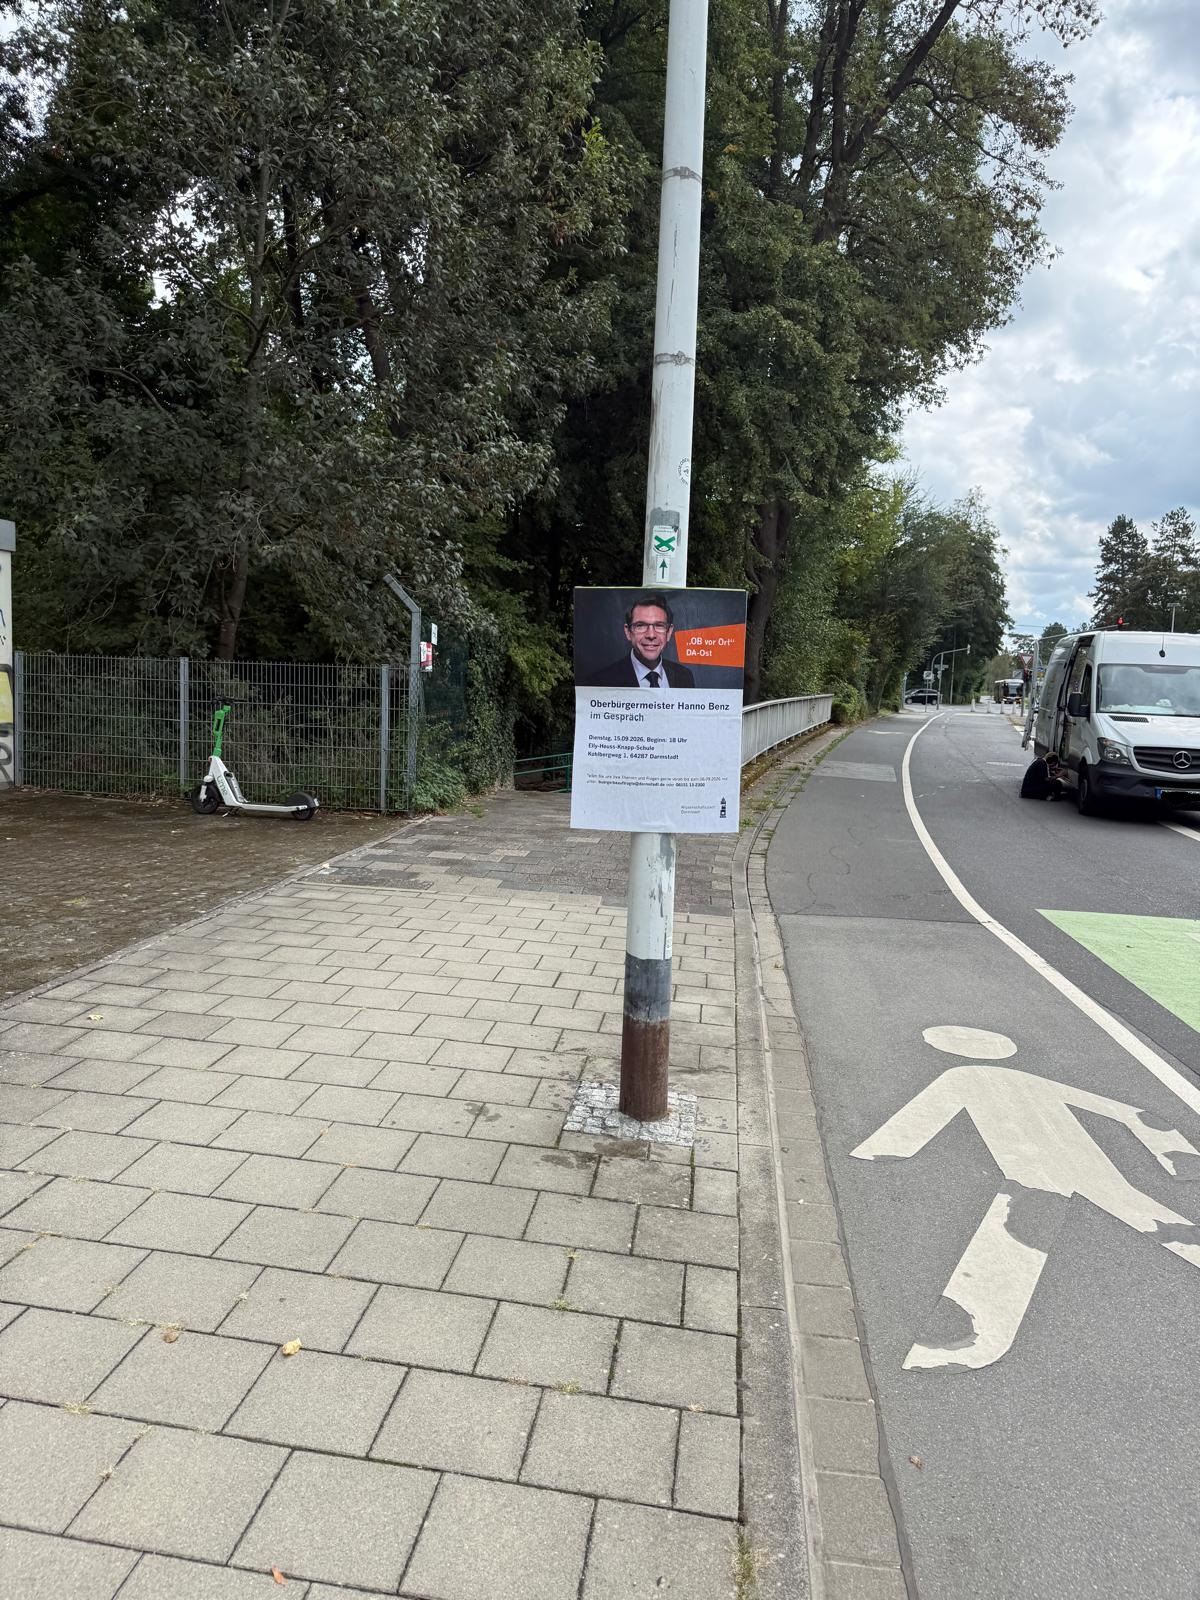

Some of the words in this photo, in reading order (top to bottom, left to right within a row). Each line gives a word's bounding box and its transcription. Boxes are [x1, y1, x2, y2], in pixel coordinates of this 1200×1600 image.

[704, 638, 717, 646] vor
[686, 649, 713, 657] DA-Ost
[590, 699, 674, 710] Oberbürgermeister
[677, 701, 706, 710] Hanno
[708, 702, 730, 711] Benz
[590, 712, 601, 720] im
[603, 712, 644, 723] Gespräch
[588, 734, 612, 742] Dienstag,
[588, 742, 655, 751] Elly-Heuss-Knapp-Schule
